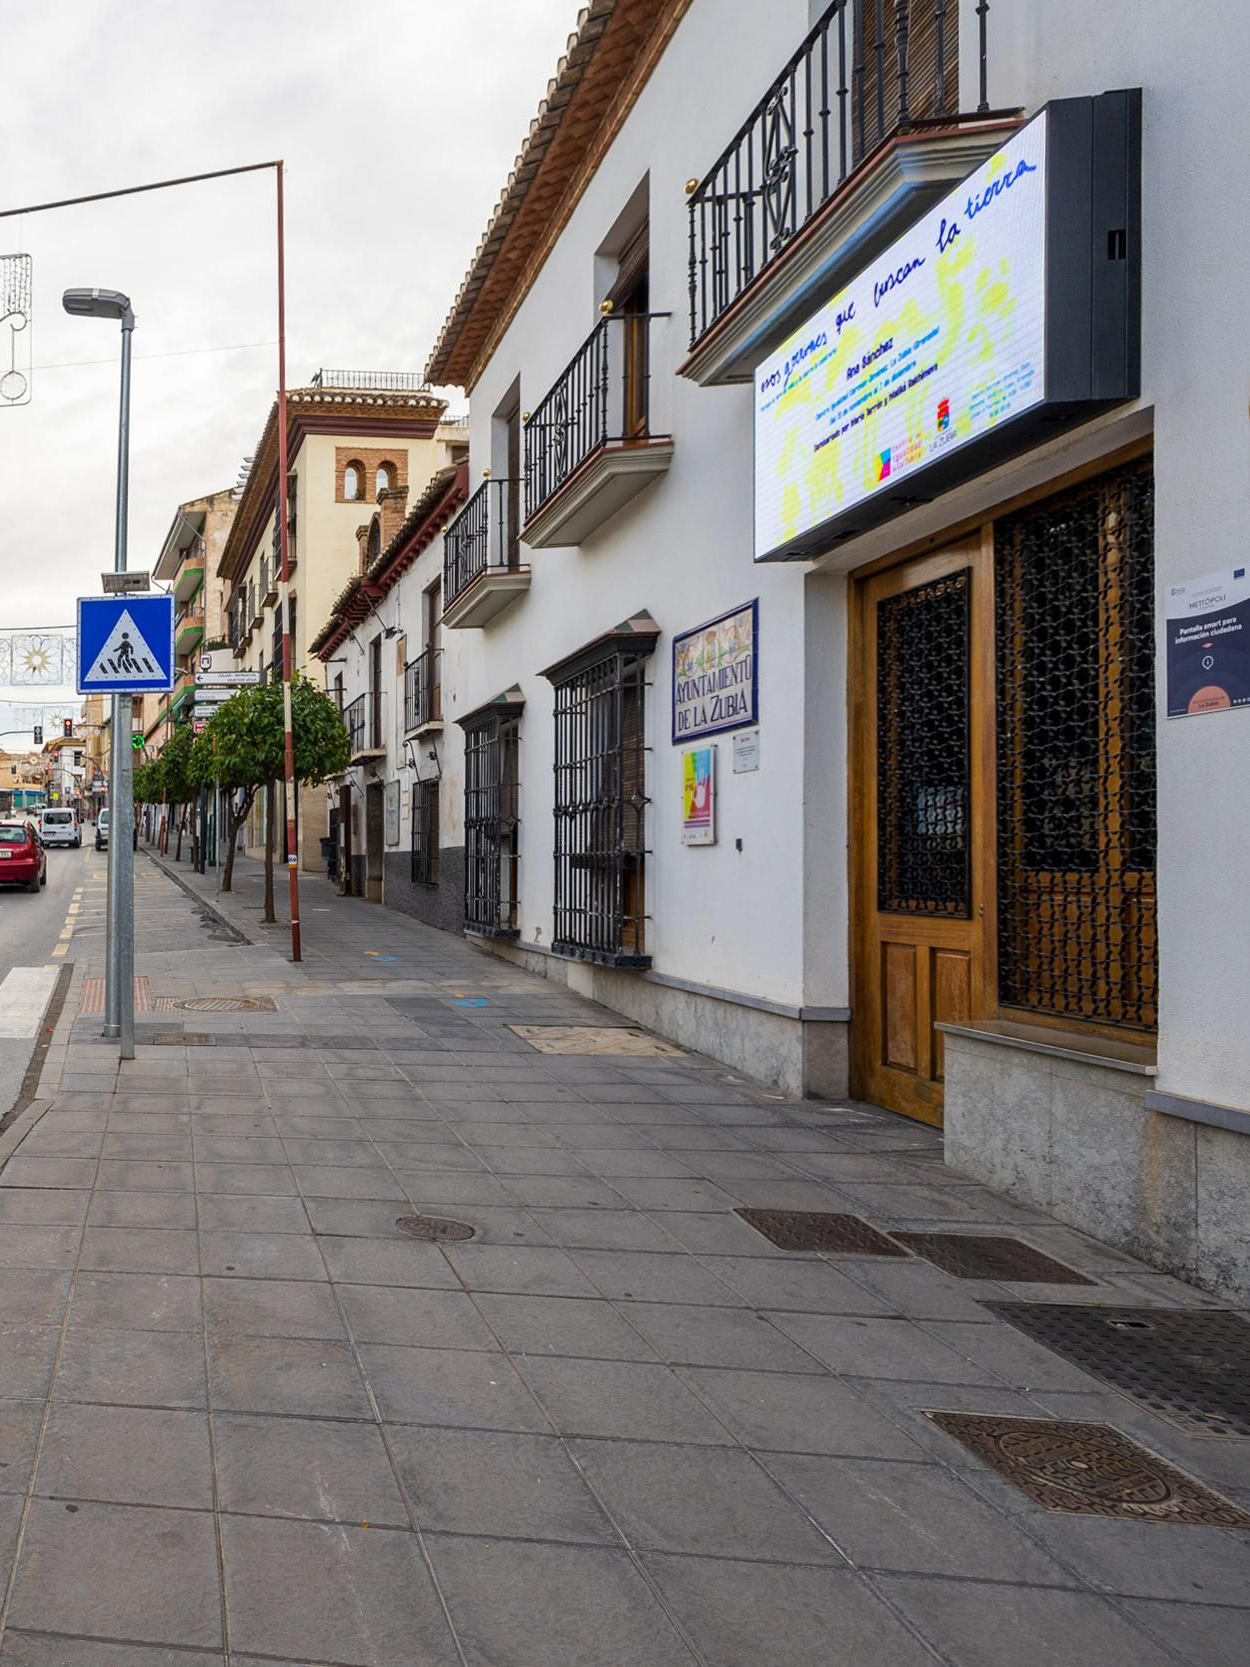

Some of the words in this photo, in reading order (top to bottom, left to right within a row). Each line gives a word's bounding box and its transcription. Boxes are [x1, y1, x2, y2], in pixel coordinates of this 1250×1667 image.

[836, 302, 855, 334] que
[936, 219, 961, 253] la
[964, 160, 1037, 219] tierra
[847, 364, 859, 380] Ana
[862, 338, 893, 369] Sánchez
[1175, 631, 1210, 644] información
[1210, 624, 1242, 636] ciudadana
[1179, 624, 1203, 636] Pantalla
[1204, 620, 1222, 630] smart
[1222, 617, 1237, 627] para
[676, 654, 751, 704] AYUNTAMIENTO
[678, 708, 691, 732] DE
[693, 702, 708, 728] LA
[710, 687, 748, 722] ZUBIA
